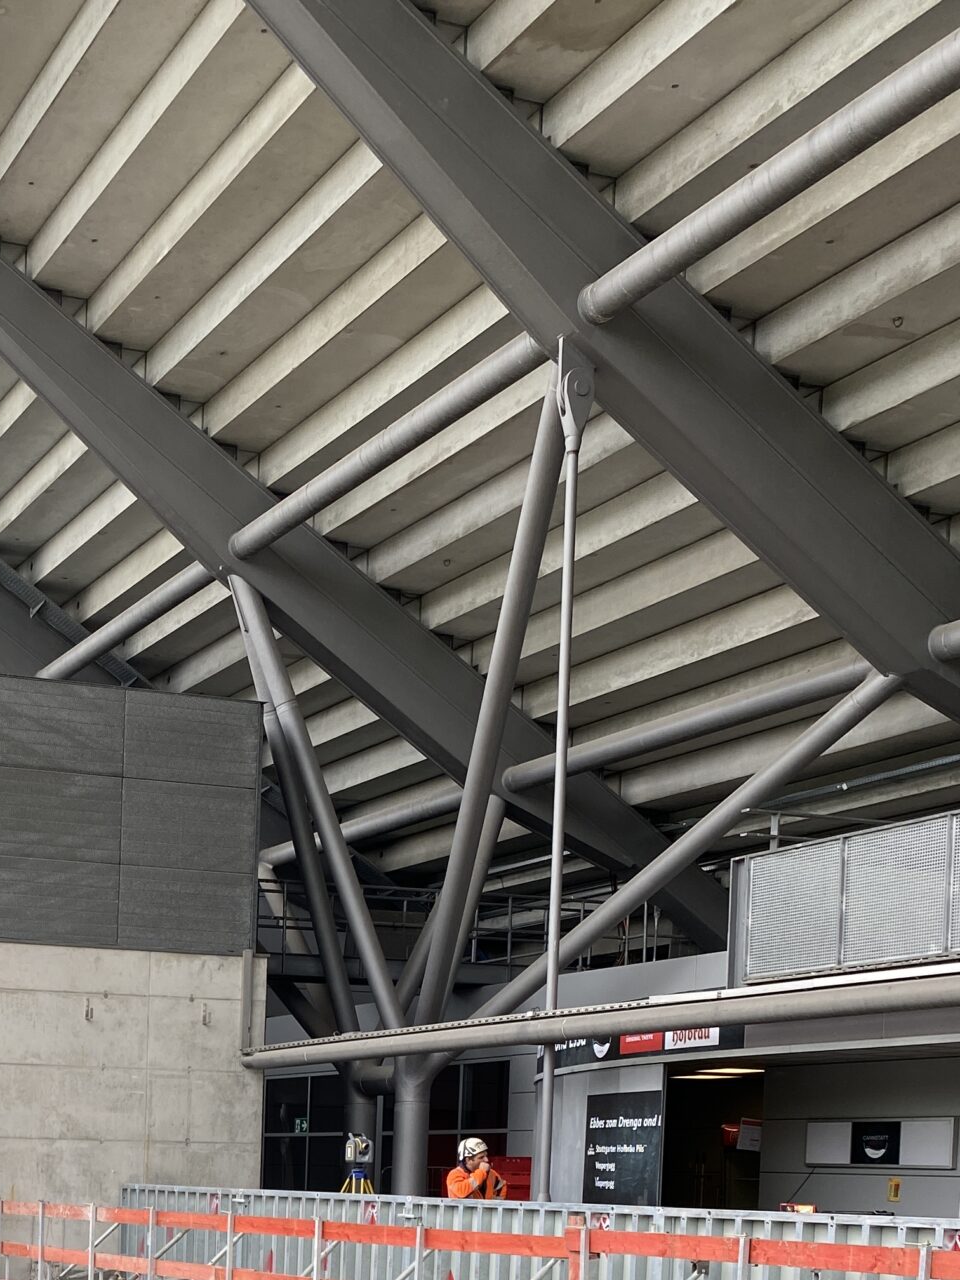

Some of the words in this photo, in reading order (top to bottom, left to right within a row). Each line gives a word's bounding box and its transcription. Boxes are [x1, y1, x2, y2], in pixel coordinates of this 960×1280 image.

[590, 1117, 604, 1128] Ebbes
[618, 1116, 642, 1131] Drenga
[643, 1114, 657, 1126] ond
